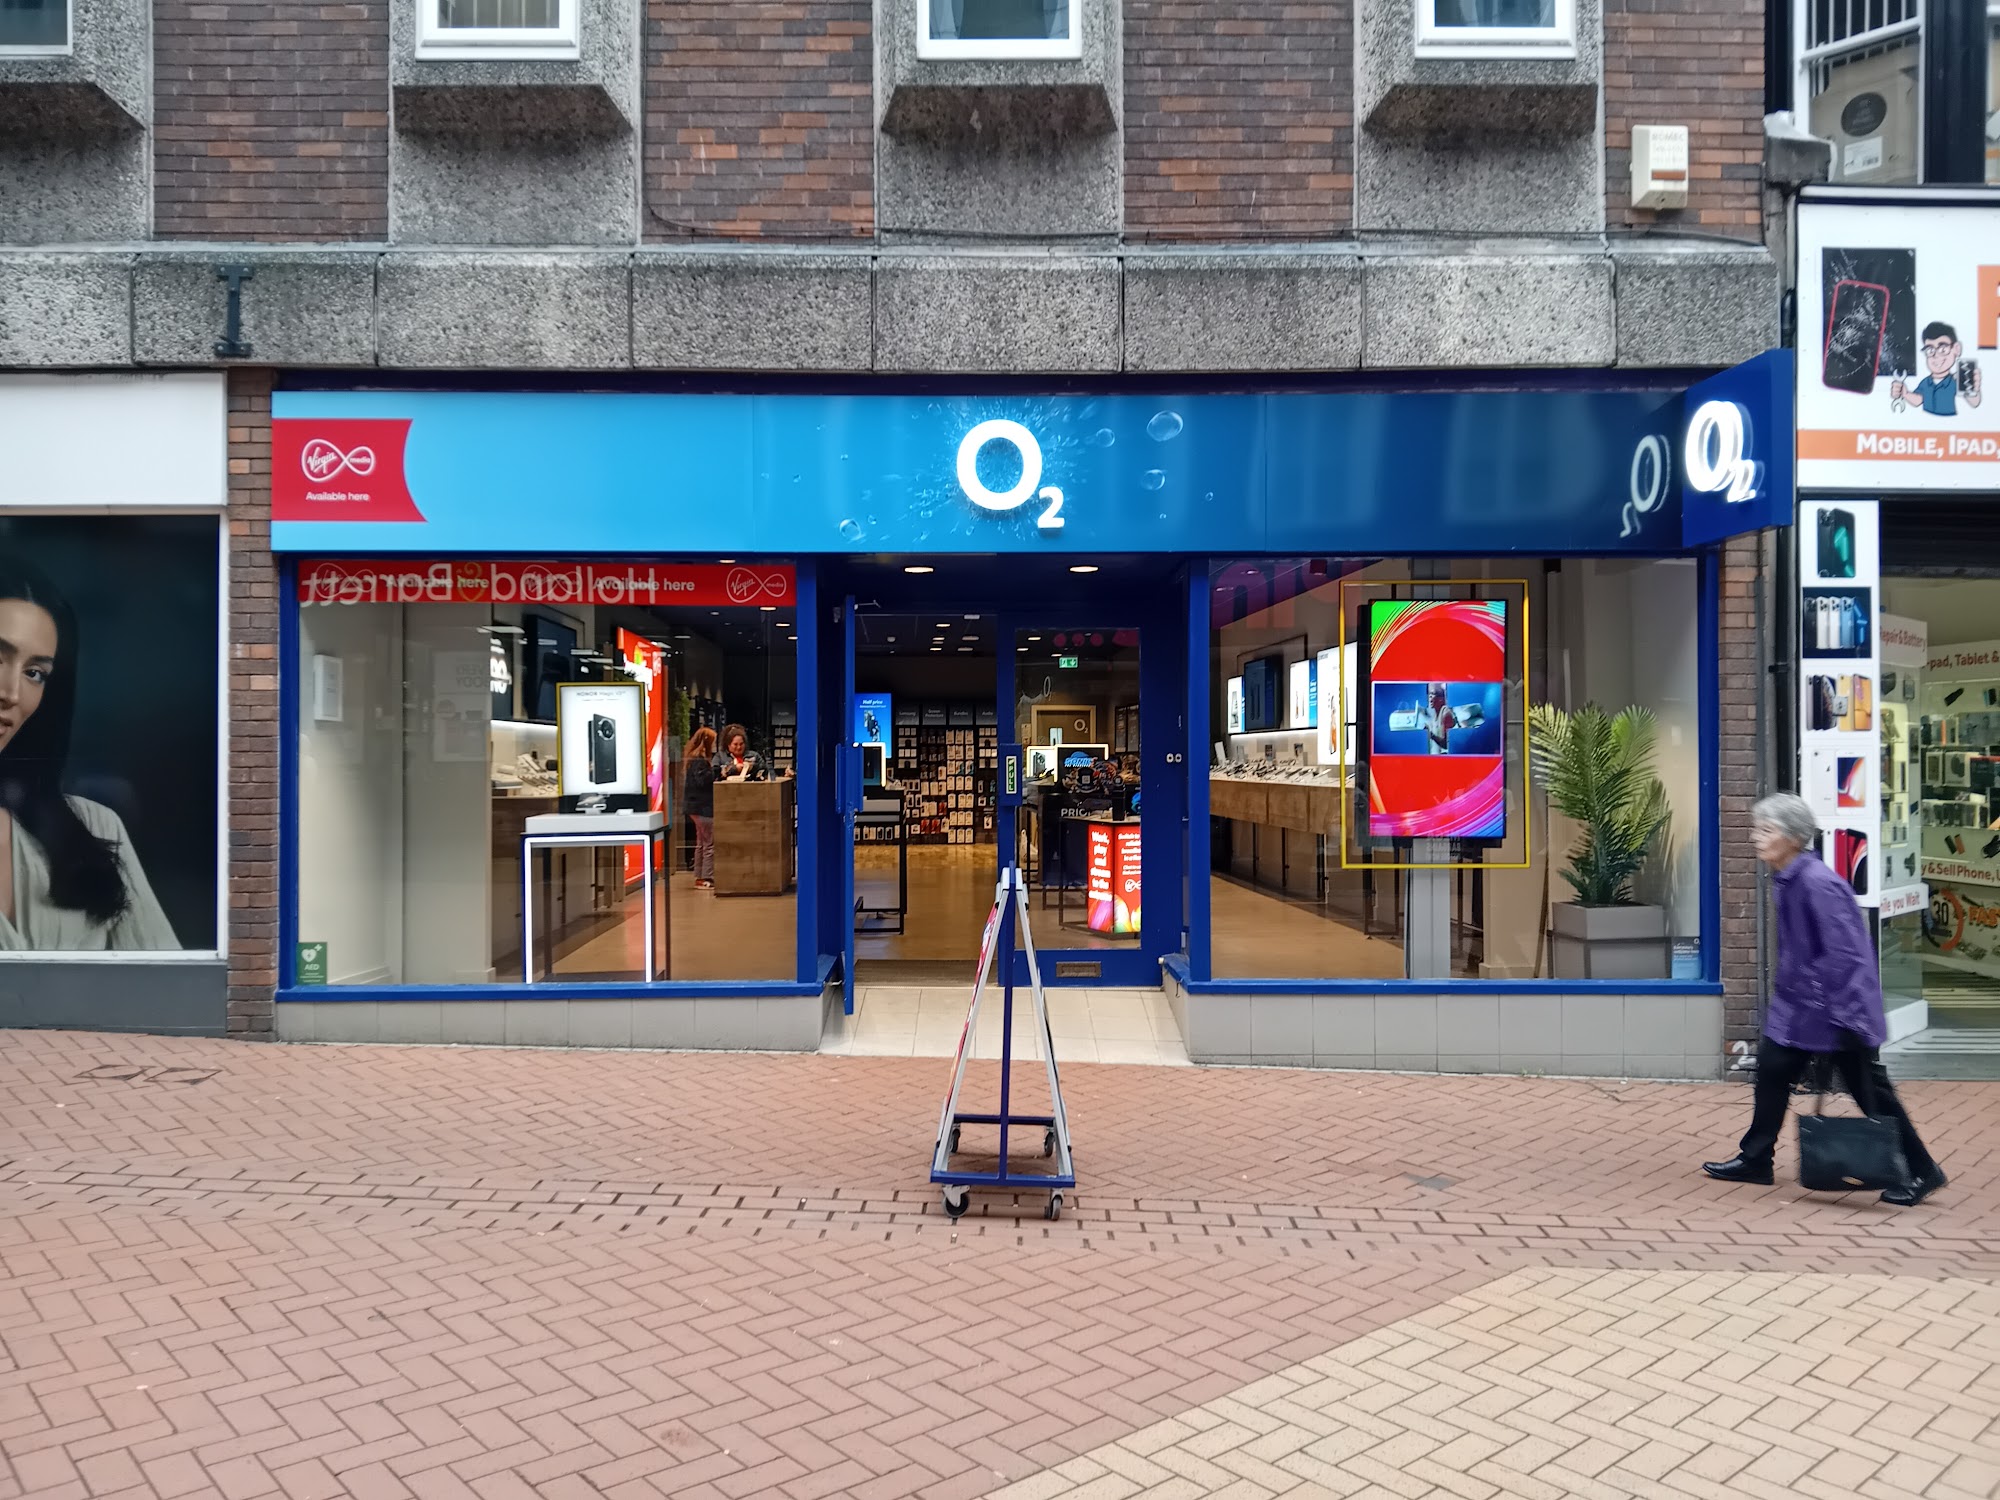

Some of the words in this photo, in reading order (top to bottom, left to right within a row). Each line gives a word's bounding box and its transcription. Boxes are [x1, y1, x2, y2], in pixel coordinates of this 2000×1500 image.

[1685, 400, 1757, 502] O2
[307, 447, 337, 474] Virgin
[350, 456, 371, 464] media
[957, 419, 1065, 528] O2
[306, 492, 347, 501] Available
[348, 492, 370, 501] here
[457, 575, 489, 589] here
[593, 577, 660, 591] Available
[663, 577, 696, 591] here
[731, 573, 755, 597] Virgin
[1955, 652, 1989, 667] Tablet
[1074, 719, 1089, 734] O2
[1936, 863, 1956, 876] Sell
[1957, 865, 1994, 882] Phone,
[1933, 901, 1949, 926] 30
[304, 963, 320, 971] AED
